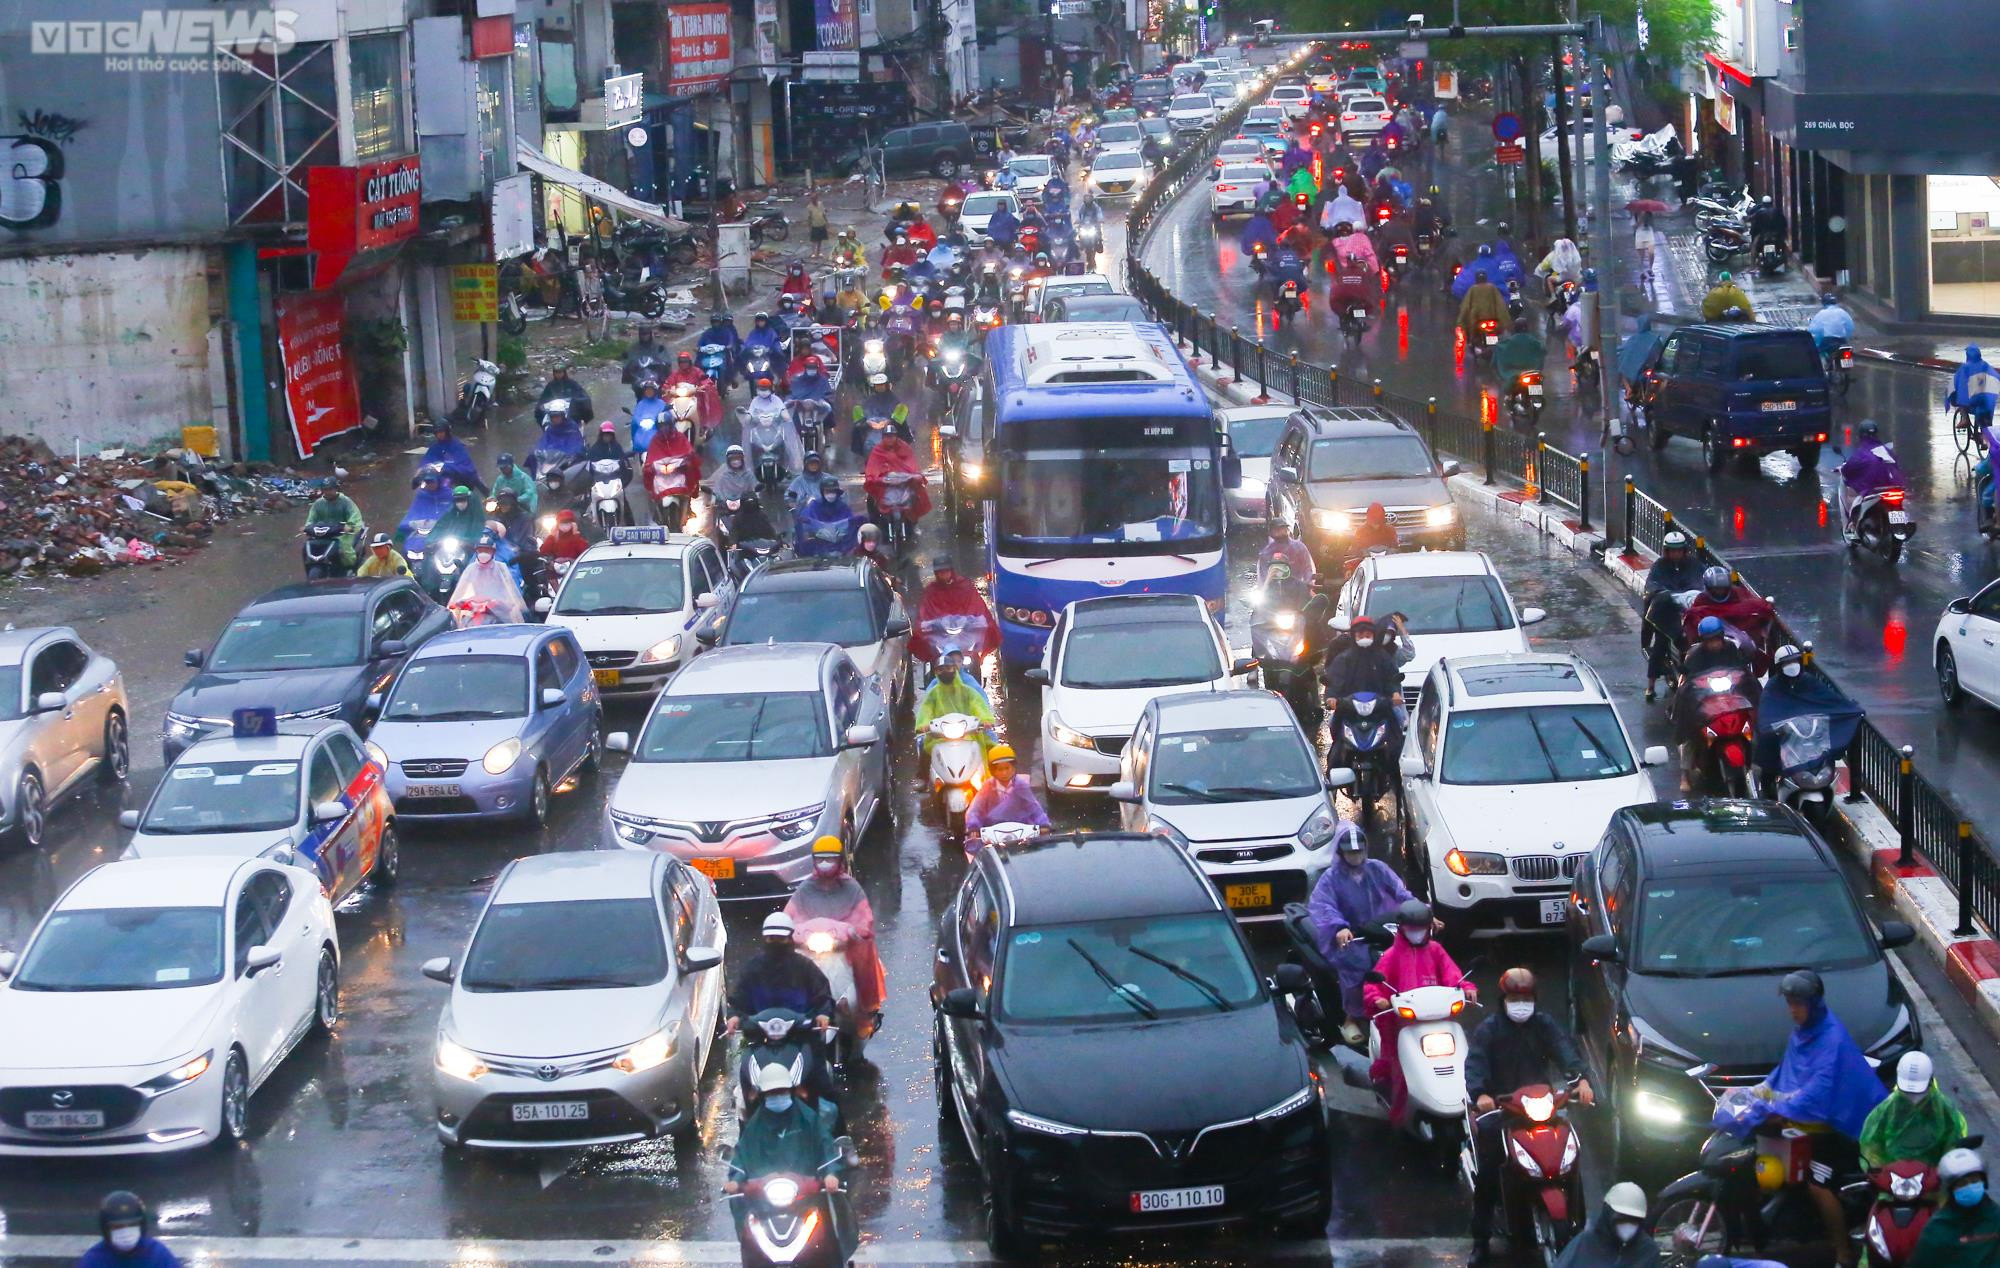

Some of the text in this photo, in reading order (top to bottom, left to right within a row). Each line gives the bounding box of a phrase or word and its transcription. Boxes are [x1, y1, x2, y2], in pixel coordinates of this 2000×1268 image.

[1804, 121, 1817, 129] 269
[1240, 886, 1259, 896] 30E
[1231, 896, 1267, 907] 741.02
[514, 1103, 587, 1120] 35A-101.25
[1142, 1188, 1223, 1209] 30G-110.10
